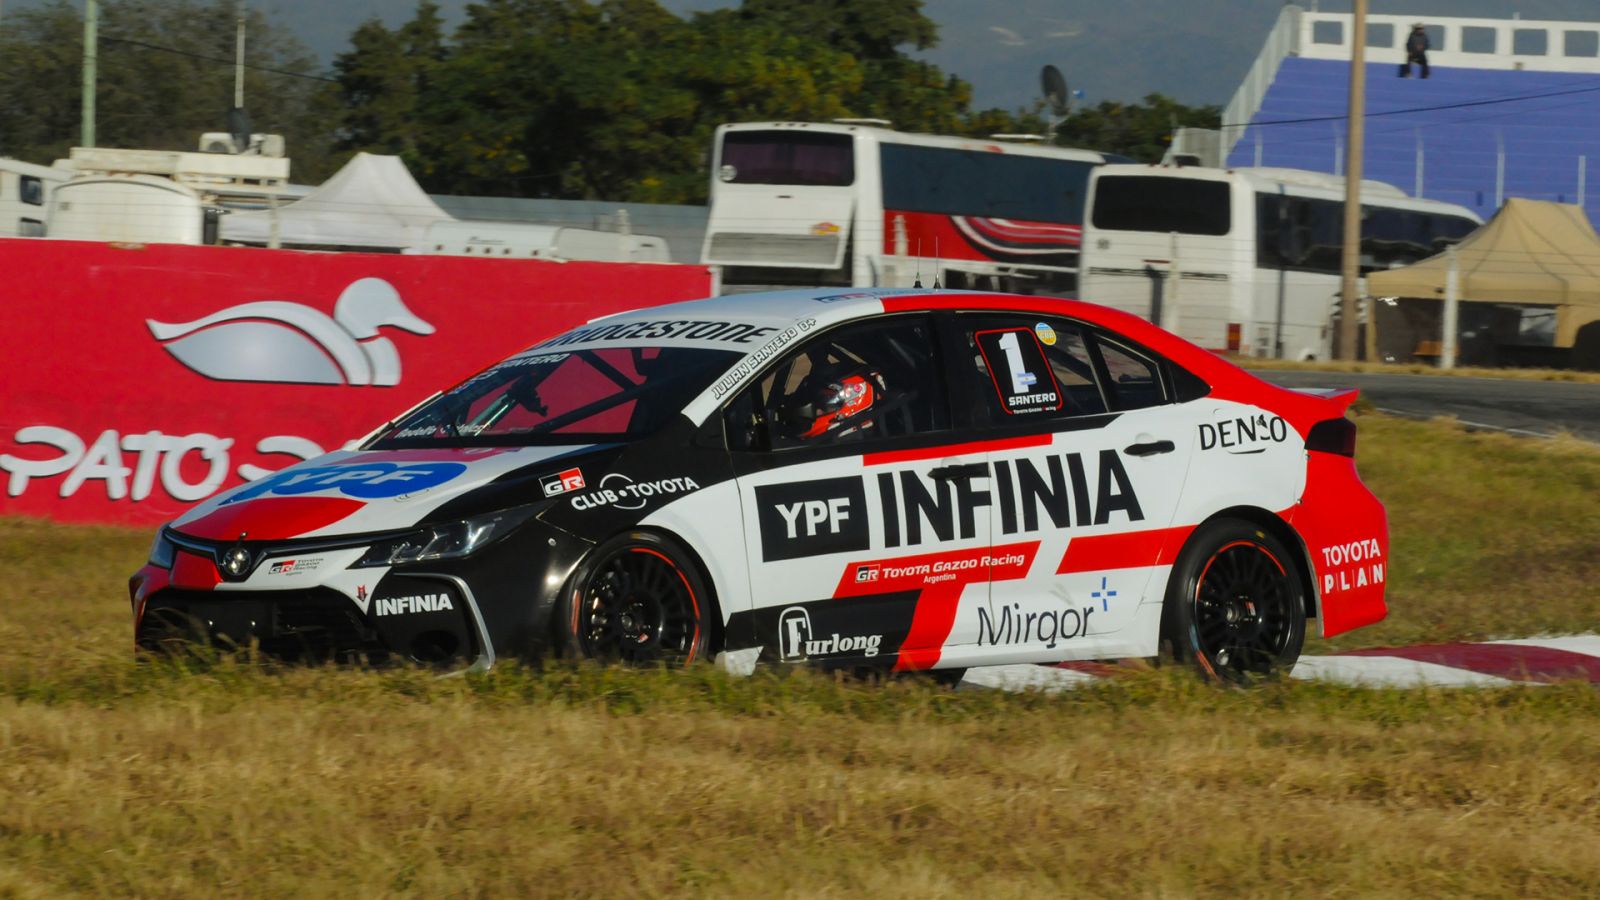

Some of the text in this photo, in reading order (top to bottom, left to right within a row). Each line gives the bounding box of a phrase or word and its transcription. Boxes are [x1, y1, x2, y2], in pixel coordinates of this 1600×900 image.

[747, 327, 798, 370] SANTERO
[998, 332, 1030, 394] 1
[1008, 392, 1057, 406] SANTERO
[0, 425, 235, 502] PATO
[276, 470, 432, 486] YPF
[545, 476, 583, 495] GR
[571, 476, 700, 511] CLUB TOYOTA
[877, 449, 1145, 548] INFINIA
[775, 497, 850, 538] YPF
[856, 570, 878, 582] GR
[980, 554, 1025, 567] Racing
[1322, 538, 1381, 567] TOYOTA
[923, 573, 956, 584] Argentina
[375, 594, 452, 617] INFINIA
[785, 615, 883, 658] Furlong
[977, 604, 1094, 649] Mirgor
